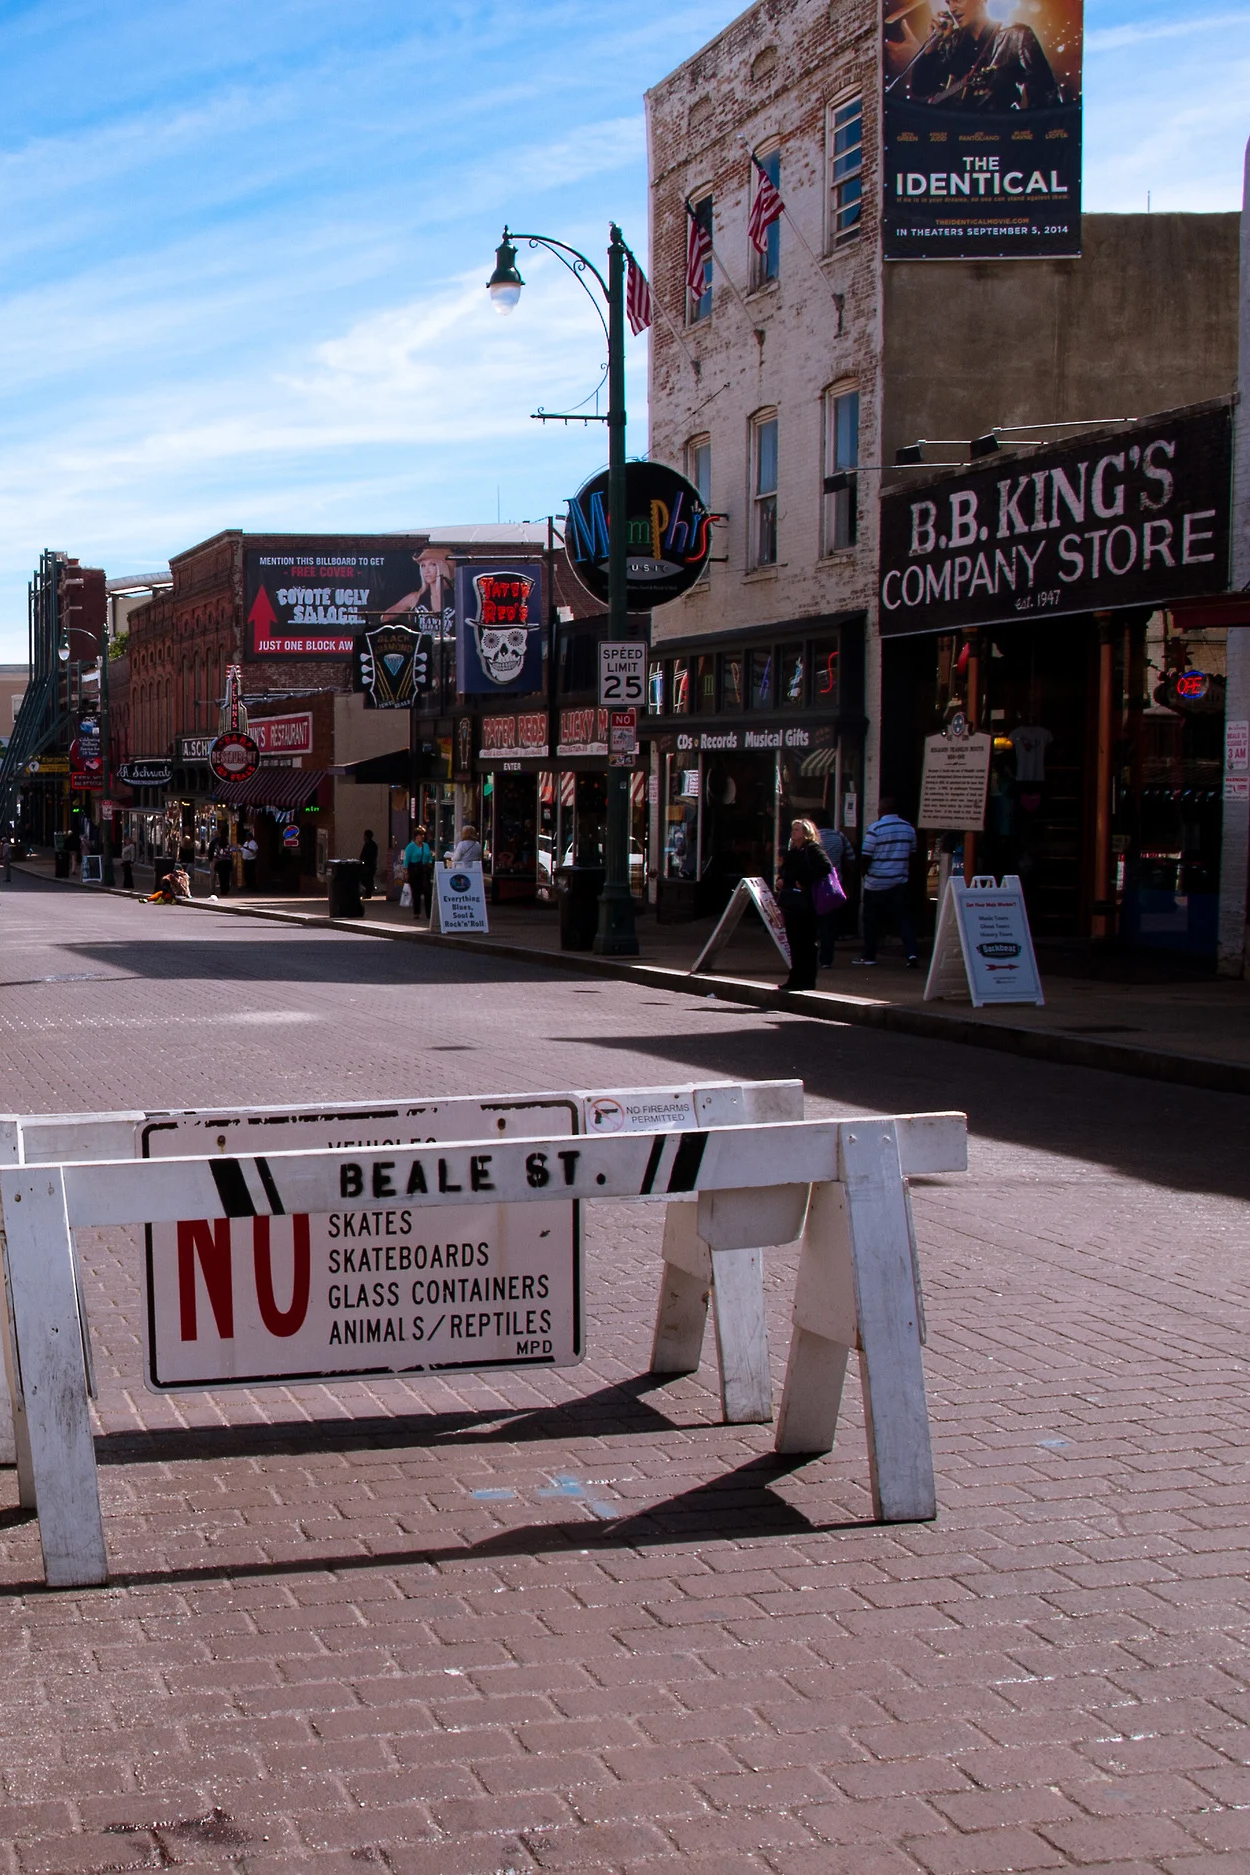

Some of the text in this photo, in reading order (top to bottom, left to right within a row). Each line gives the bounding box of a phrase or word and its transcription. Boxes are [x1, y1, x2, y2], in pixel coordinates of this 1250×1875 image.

[962, 156, 1000, 171] THE
[896, 170, 1068, 196] IDENTICAL
[936, 217, 1030, 226] THEIDENTICALMOVIE.COM
[896, 225, 1069, 237] IN THEATERS SEPTEMBER 5, 2014
[996, 439, 1177, 540] KING'S
[563, 491, 721, 565] Mmphis
[259, 557, 385, 566] MENTION THIS BILLBOARD TO GET
[882, 509, 1217, 611] COMPANY STORE
[291, 566, 354, 578] FREE COVER
[628, 564, 670, 573] USIC
[276, 587, 370, 606] COYOTE UGLY
[1014, 590, 1062, 611] est. 1947
[258, 640, 354, 651] JUST ONE BLOCK AW
[377, 634, 410, 643] BLACK
[374, 643, 414, 654] DIAMOND
[603, 649, 643, 660] SPEED
[607, 662, 639, 673] LIMIT
[604, 675, 642, 699] 25
[1177, 676, 1204, 695] OPE
[561, 709, 595, 743] LUCKY
[615, 715, 631, 725] NO
[270, 721, 309, 746] RESTAURANT
[483, 716, 516, 747] TATER
[677, 728, 810, 750] CDs Records Musical Gifts
[211, 750, 258, 765] RESTAURANT
[1228, 748, 1246, 759] 3 AM
[503, 762, 522, 771] ENTER
[443, 895, 481, 903] Everything
[982, 944, 1017, 953] Backbeat
[626, 1104, 690, 1115] NO FIREARMS
[631, 1114, 686, 1124] PERMITTED
[338, 1150, 608, 1200] BEALE ST.
[327, 1210, 413, 1239] SKATES
[327, 1242, 490, 1276] SKATEBOARDS
[176, 1213, 312, 1342] NO
[327, 1273, 550, 1312] GLASS CONTAINERS
[328, 1308, 552, 1348] ANIMALS/REPTILES
[515, 1340, 553, 1357] MPD
